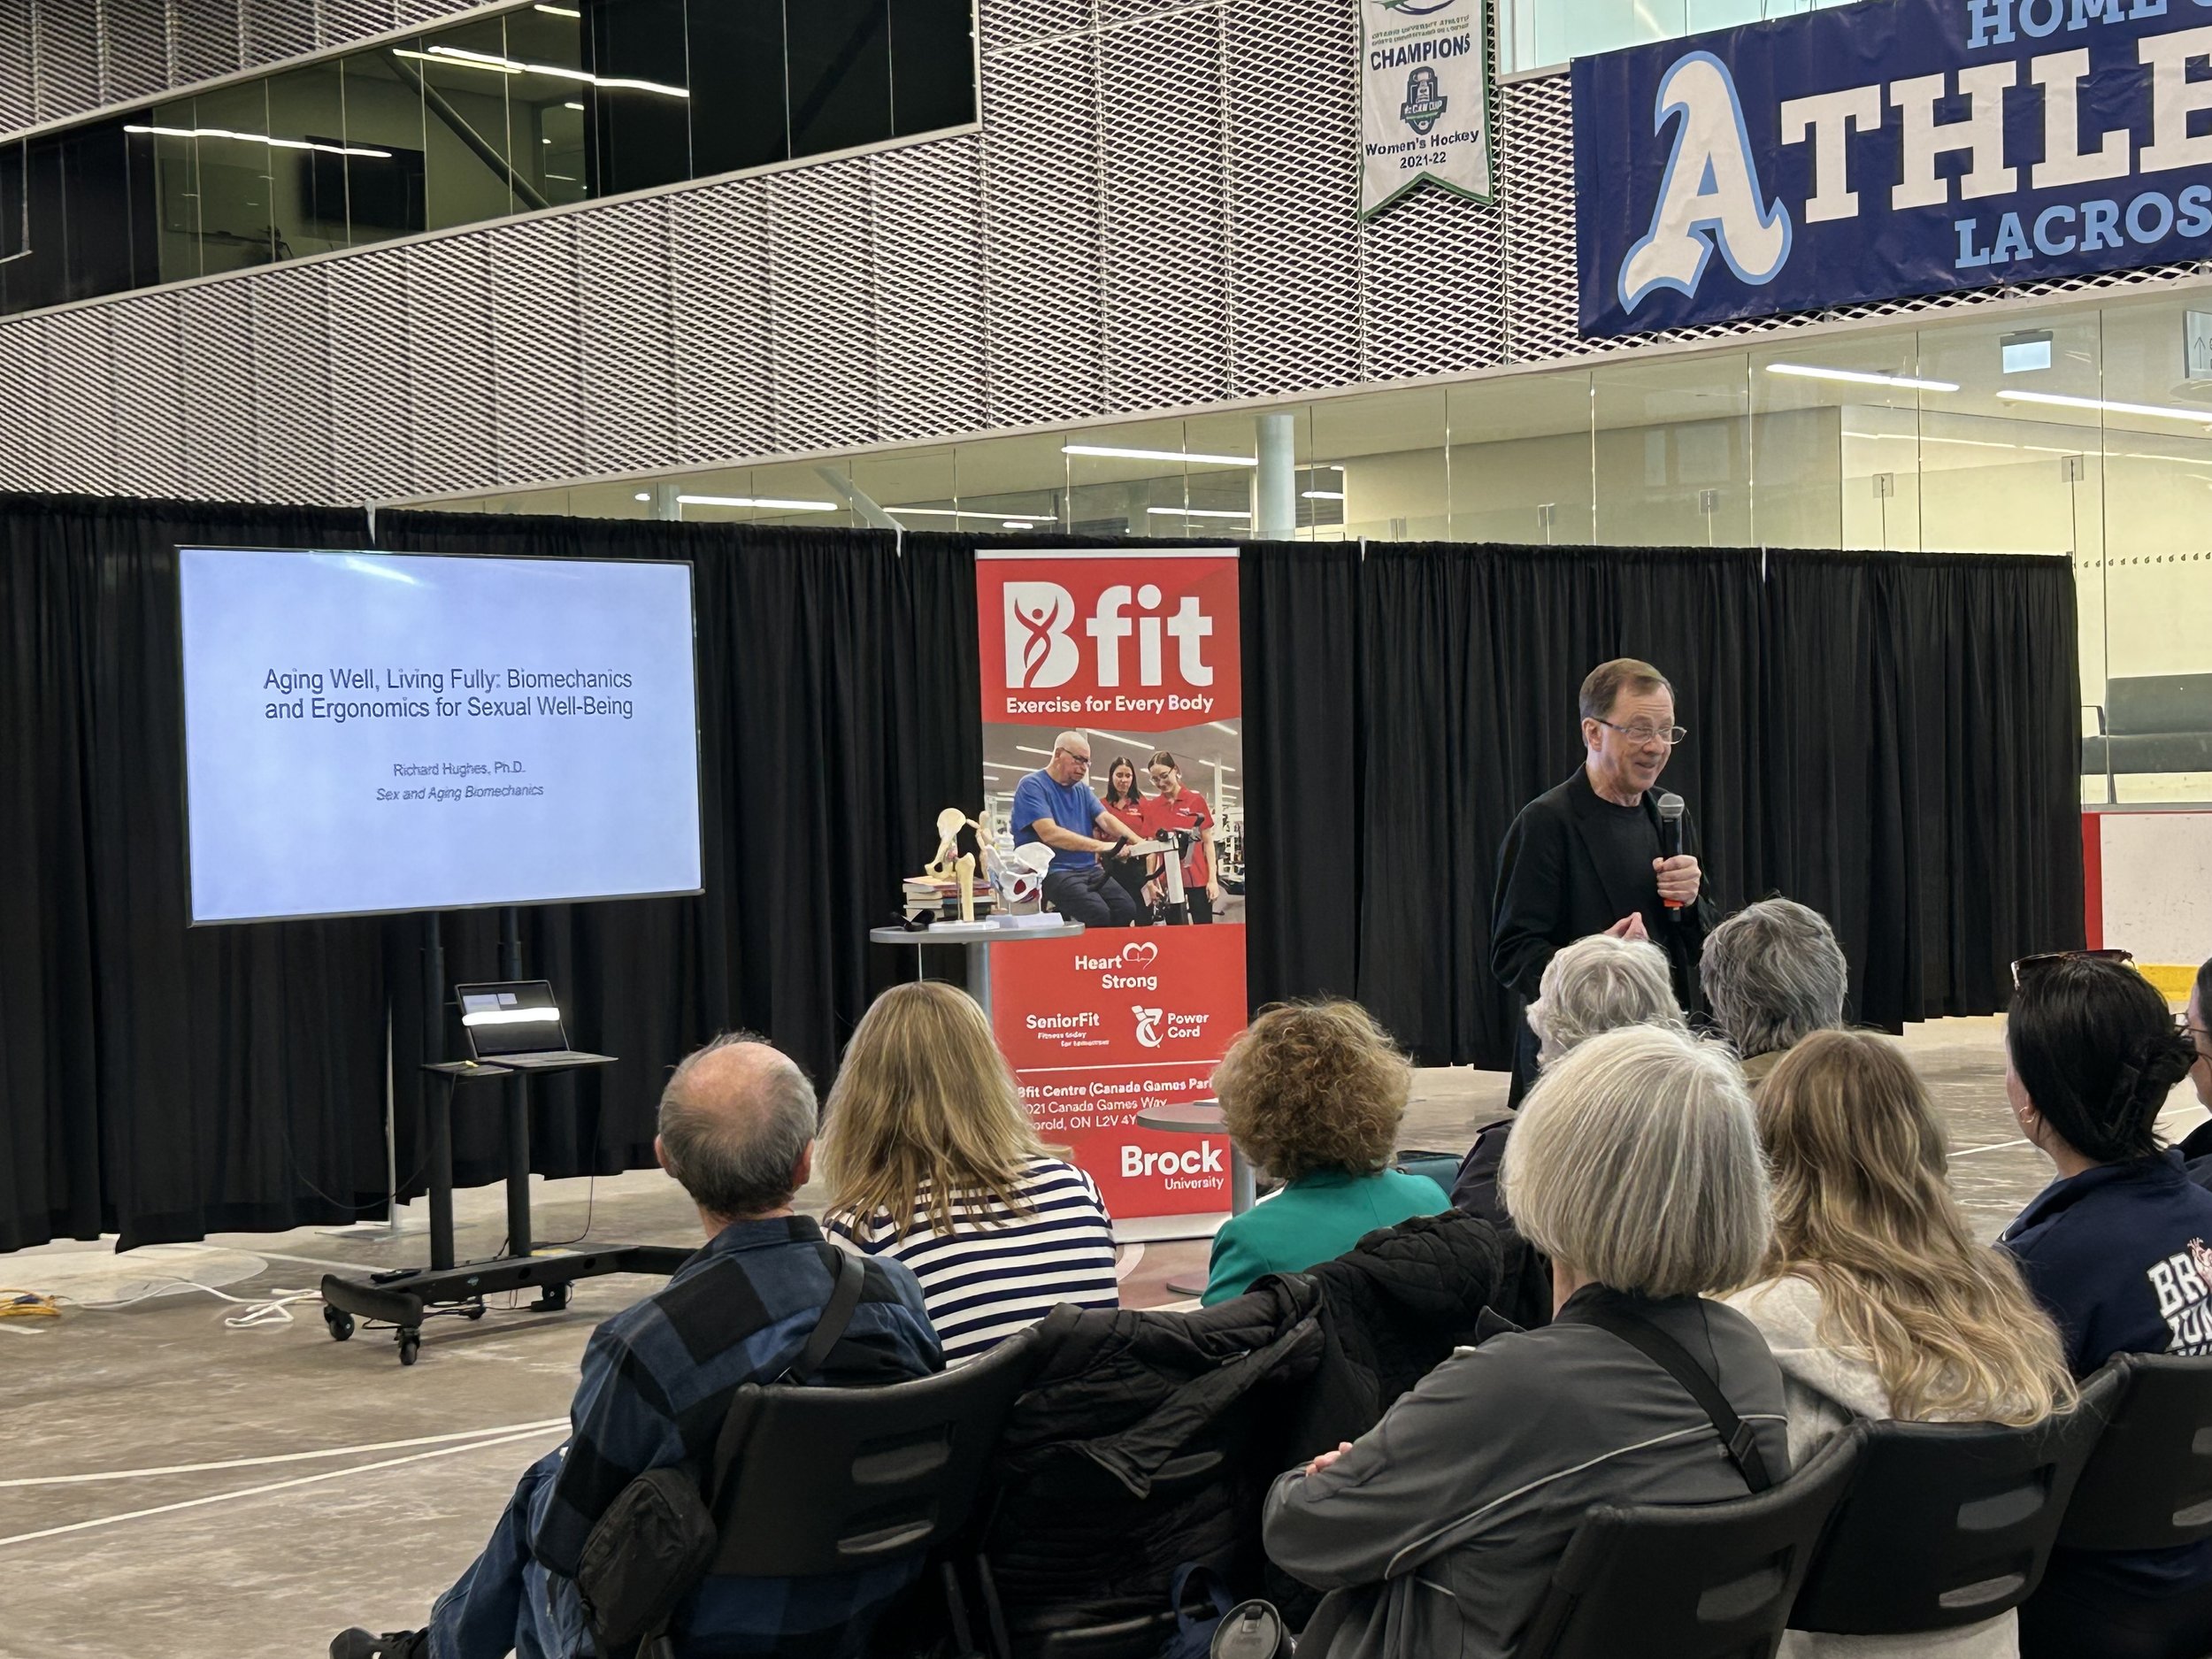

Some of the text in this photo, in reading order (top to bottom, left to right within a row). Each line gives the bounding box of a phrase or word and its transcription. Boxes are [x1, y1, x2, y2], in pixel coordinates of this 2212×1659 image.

[1371, 33, 1471, 71] CHAMPIONS
[1365, 130, 1479, 157] Women's Hockey
[1400, 151, 1447, 169] 2021-22
[1954, 185, 2212, 269] LACROS
[1003, 581, 1213, 688] Bfit
[264, 667, 633, 695] Aging Well, Living Fully: Biomechanics
[265, 696, 633, 723] and Ergonomics for Sexual Well-Being
[1006, 694, 1214, 714] Exercise for Every Body
[393, 760, 526, 778] Richard Hughes, Ph.D.
[376, 783, 544, 802] Sex and Aging Biomechanics
[1075, 955, 1122, 971] Heart
[1102, 974, 1157, 991] Strong
[1025, 1011, 1100, 1030] SeniorFit
[1167, 1012, 1210, 1025] Power
[1167, 1025, 1200, 1039] Cord
[1042, 1085, 1087, 1097] Centre
[1089, 1080, 1141, 1097] (Canada
[1143, 1079, 1187, 1093] Games
[1025, 1102, 1046, 1115] 021
[1048, 1100, 1094, 1113] Canada
[1096, 1098, 1138, 1111] Games
[1033, 1114, 1137, 1131] orold, ON L2V 4Y
[1121, 1141, 1223, 1178] Brock
[1164, 1176, 1225, 1191] University
